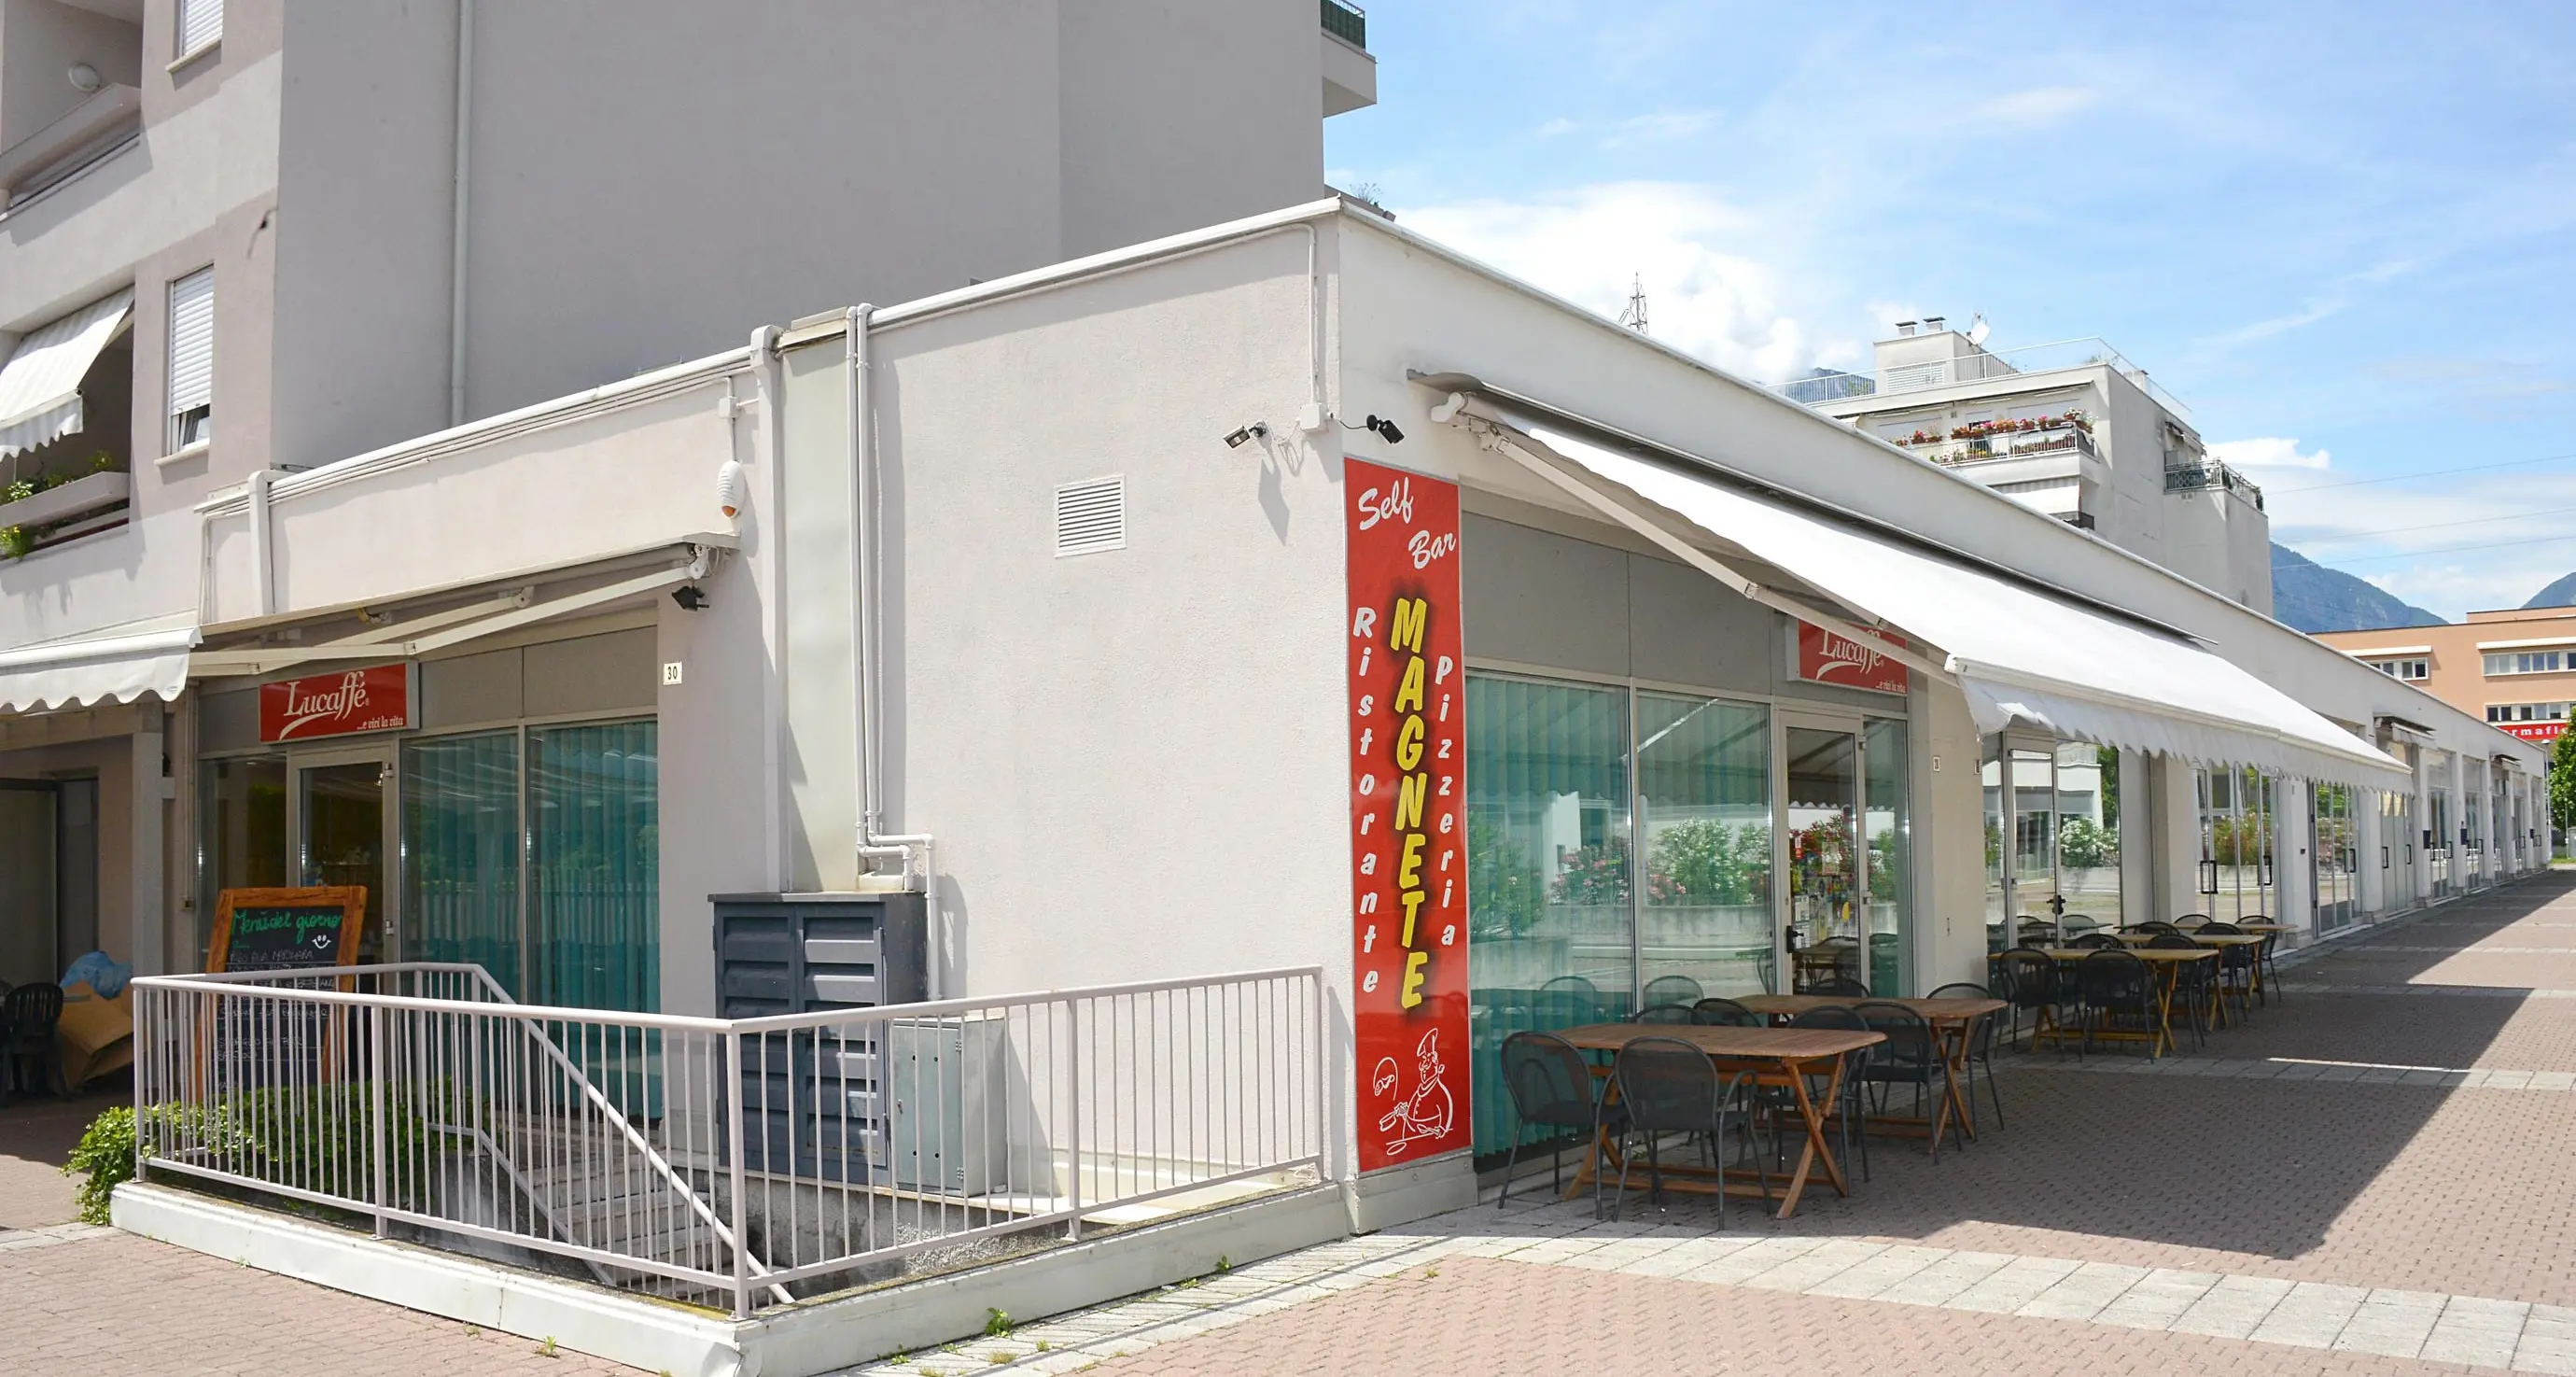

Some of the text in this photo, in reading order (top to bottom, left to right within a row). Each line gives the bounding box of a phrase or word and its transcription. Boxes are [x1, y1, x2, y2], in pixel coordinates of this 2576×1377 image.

[1358, 476, 1414, 530] Self
[1408, 529, 1457, 569] Bar
[284, 671, 365, 720] Lucaffé
[667, 666, 678, 680] 30
[1352, 607, 1379, 992] Ristorante
[1390, 597, 1428, 1009] MAGNETE
[1435, 655, 1456, 946] Pizzeria
[295, 914, 343, 945] giorno
